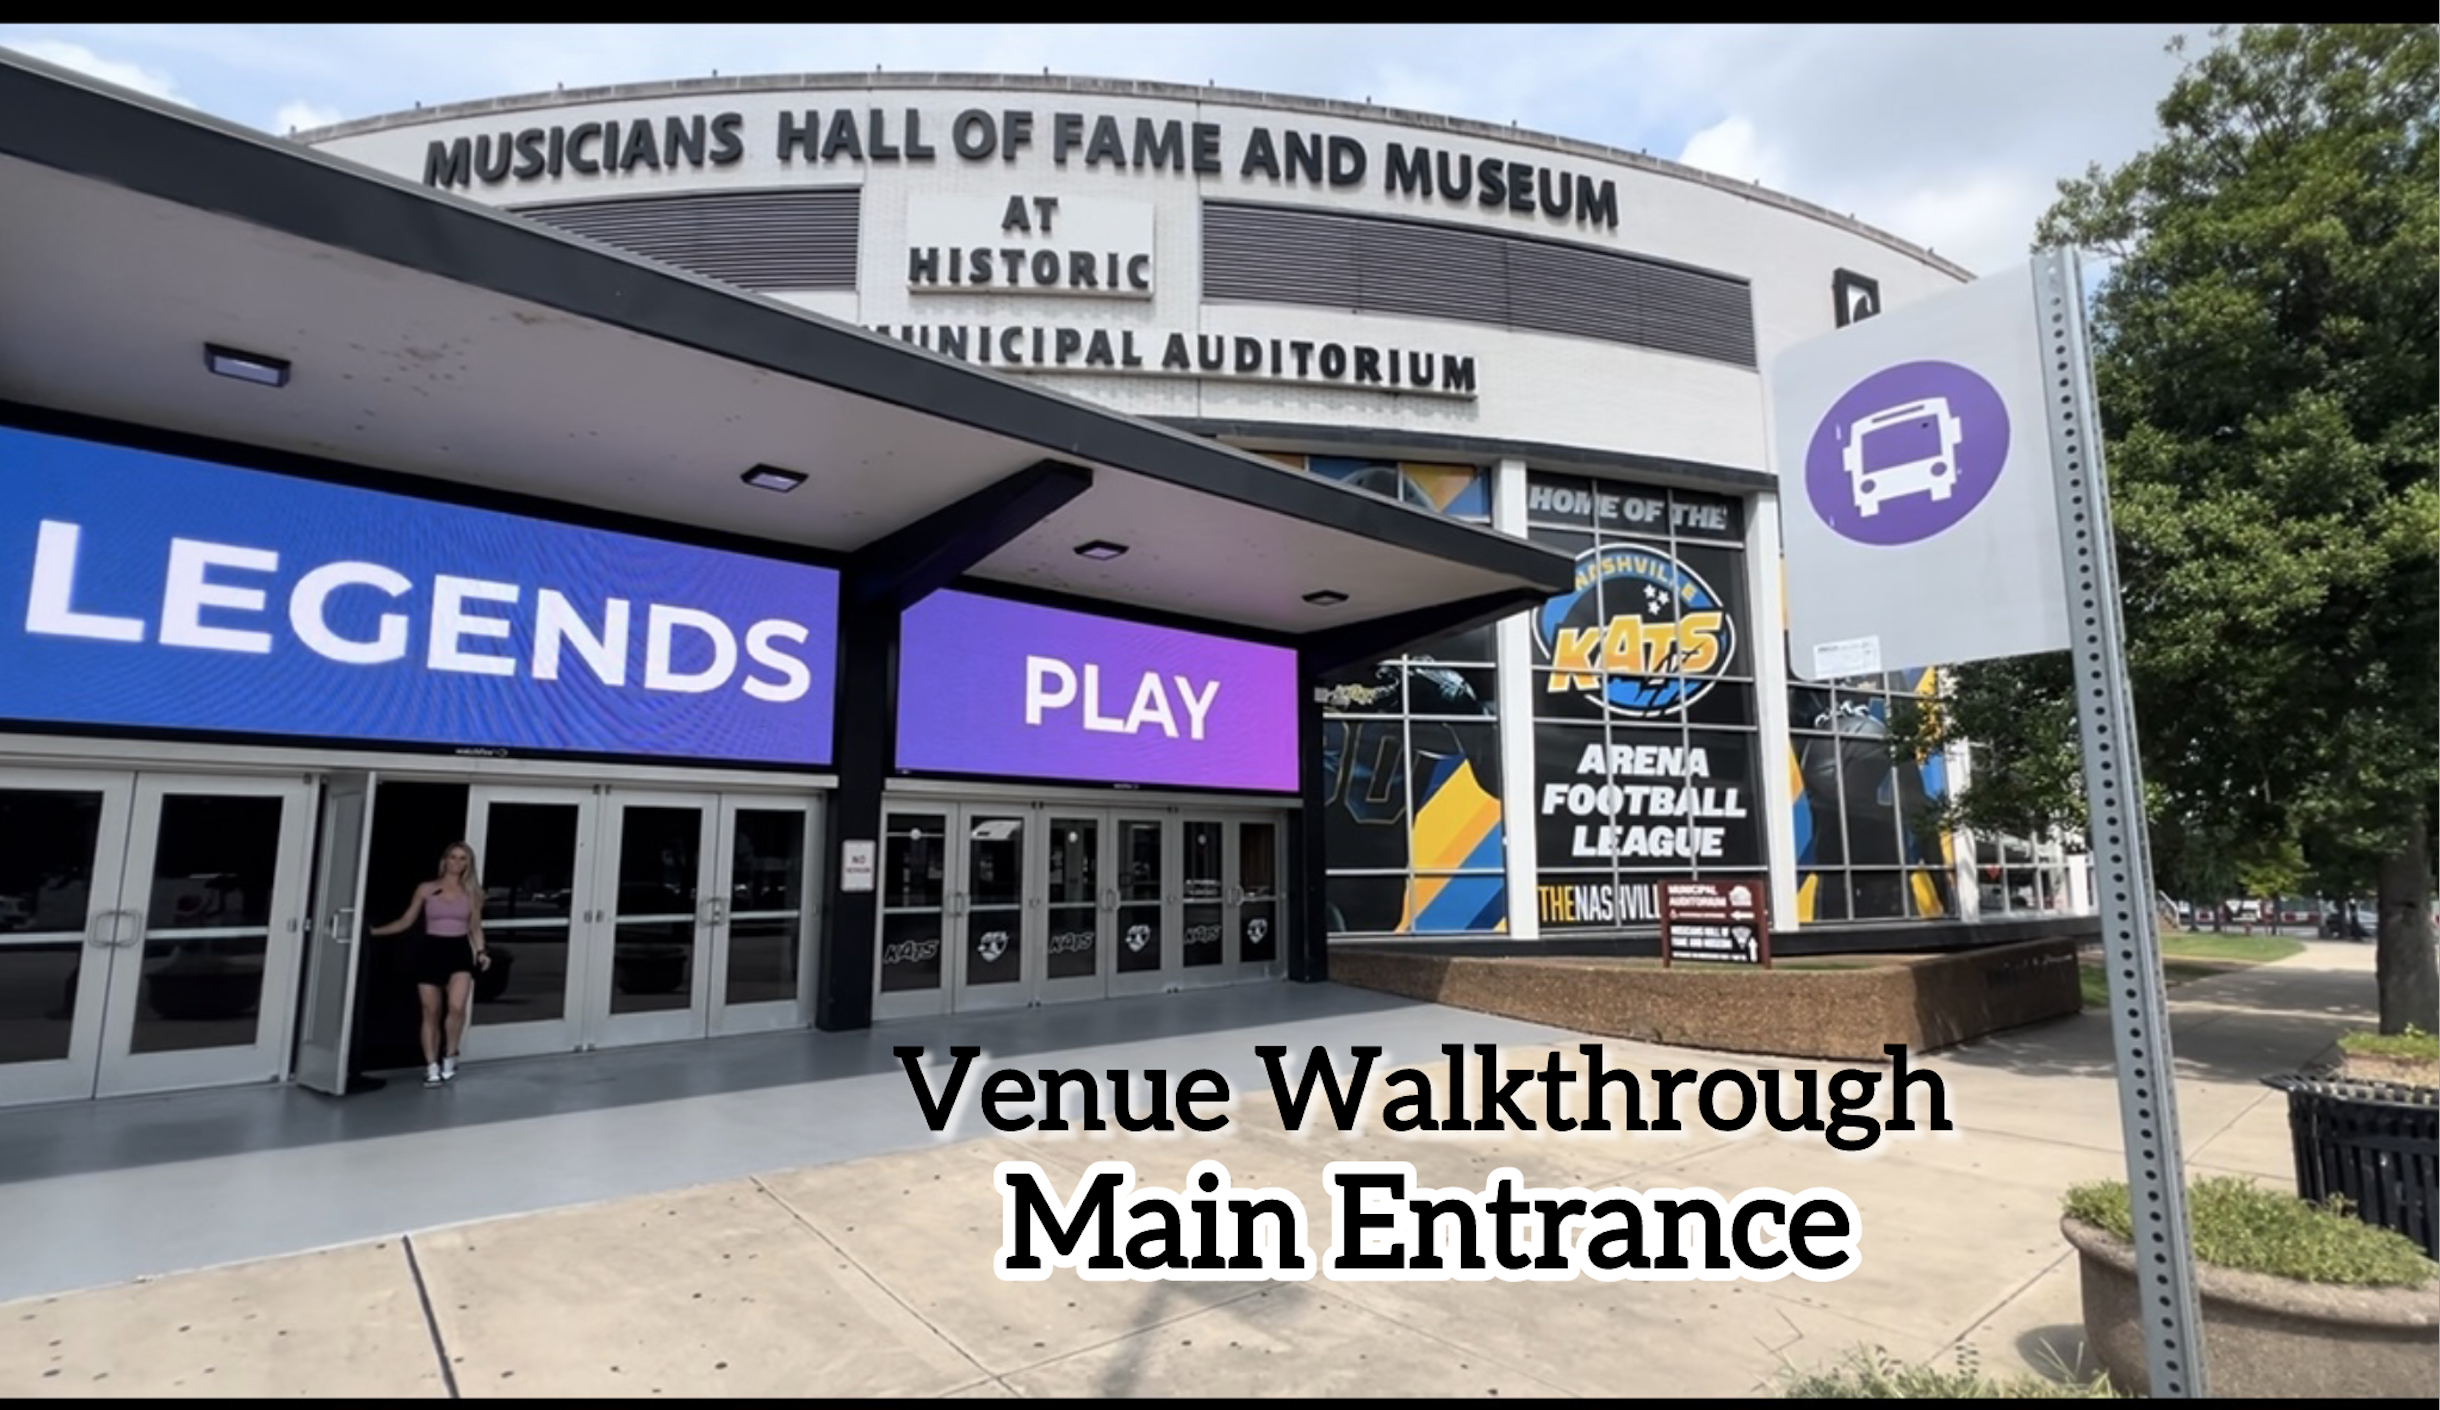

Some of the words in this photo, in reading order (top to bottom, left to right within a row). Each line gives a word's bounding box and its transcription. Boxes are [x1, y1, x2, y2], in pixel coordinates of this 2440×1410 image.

[424, 112, 746, 188] MUSICIANS
[777, 108, 935, 163] HALL
[952, 108, 1033, 161] OF
[1054, 111, 1222, 173] FAME
[1240, 126, 1368, 187] AND
[1385, 142, 1619, 229] MUSEUM
[1001, 195, 1058, 232] AT
[908, 246, 1150, 290] HISTORIC
[864, 324, 1143, 367] UNICIPAL
[1161, 332, 1477, 393] AUDITORIUM
[1528, 486, 1620, 519] HOME
[1623, 496, 1664, 523] OF
[1672, 502, 1728, 531] THE
[24, 518, 812, 702] LEGENDS
[1546, 611, 1723, 694] KATS
[1025, 654, 1221, 742] PLAY
[1576, 743, 1711, 778] ARENA
[1541, 783, 1748, 818] FOOTBALL
[1572, 825, 1726, 858] LEAGUE
[882, 939, 940, 964] KATS
